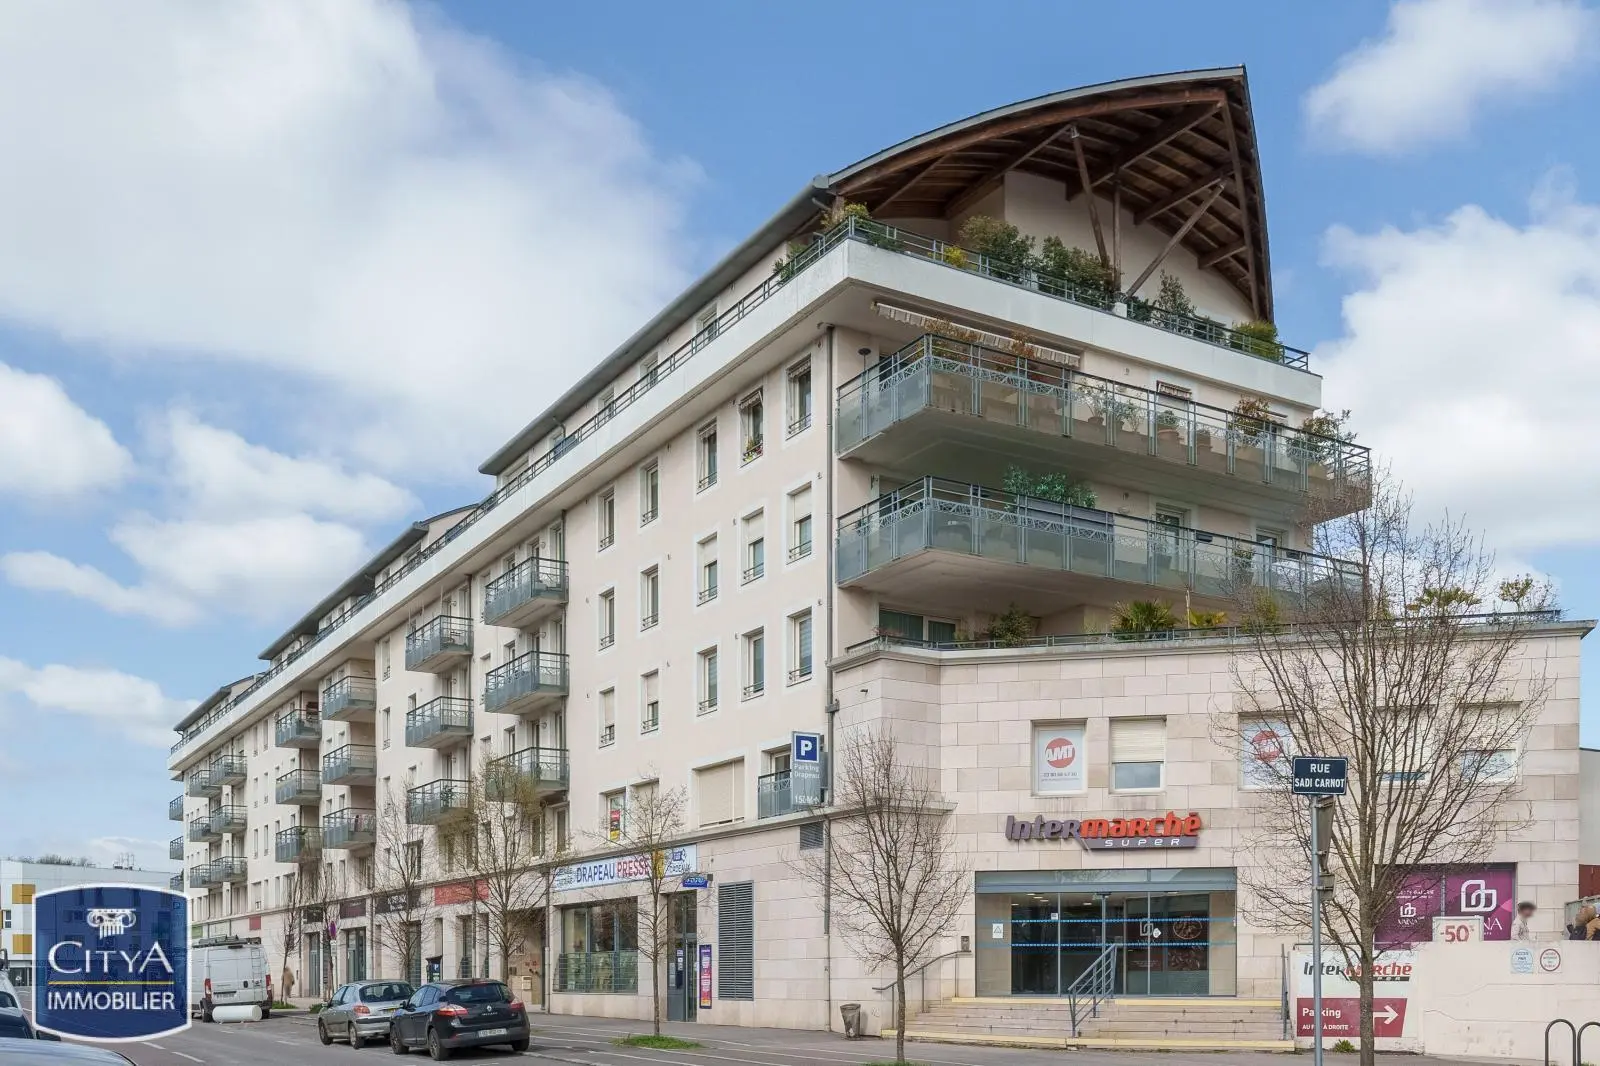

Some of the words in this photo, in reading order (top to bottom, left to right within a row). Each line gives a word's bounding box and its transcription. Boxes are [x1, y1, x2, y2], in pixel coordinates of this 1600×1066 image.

[800, 739, 813, 757] P
[794, 763, 819, 773] Parking
[1310, 763, 1330, 774] RUE
[1294, 777, 1313, 788] SADI
[1314, 777, 1345, 788] CARNOT
[1005, 811, 1201, 842] Intermarché
[1104, 837, 1181, 847] SUPER
[576, 862, 616, 883] DRAPEAU
[616, 857, 651, 878] PRESSE
[1302, 1007, 1341, 1019] Paking
